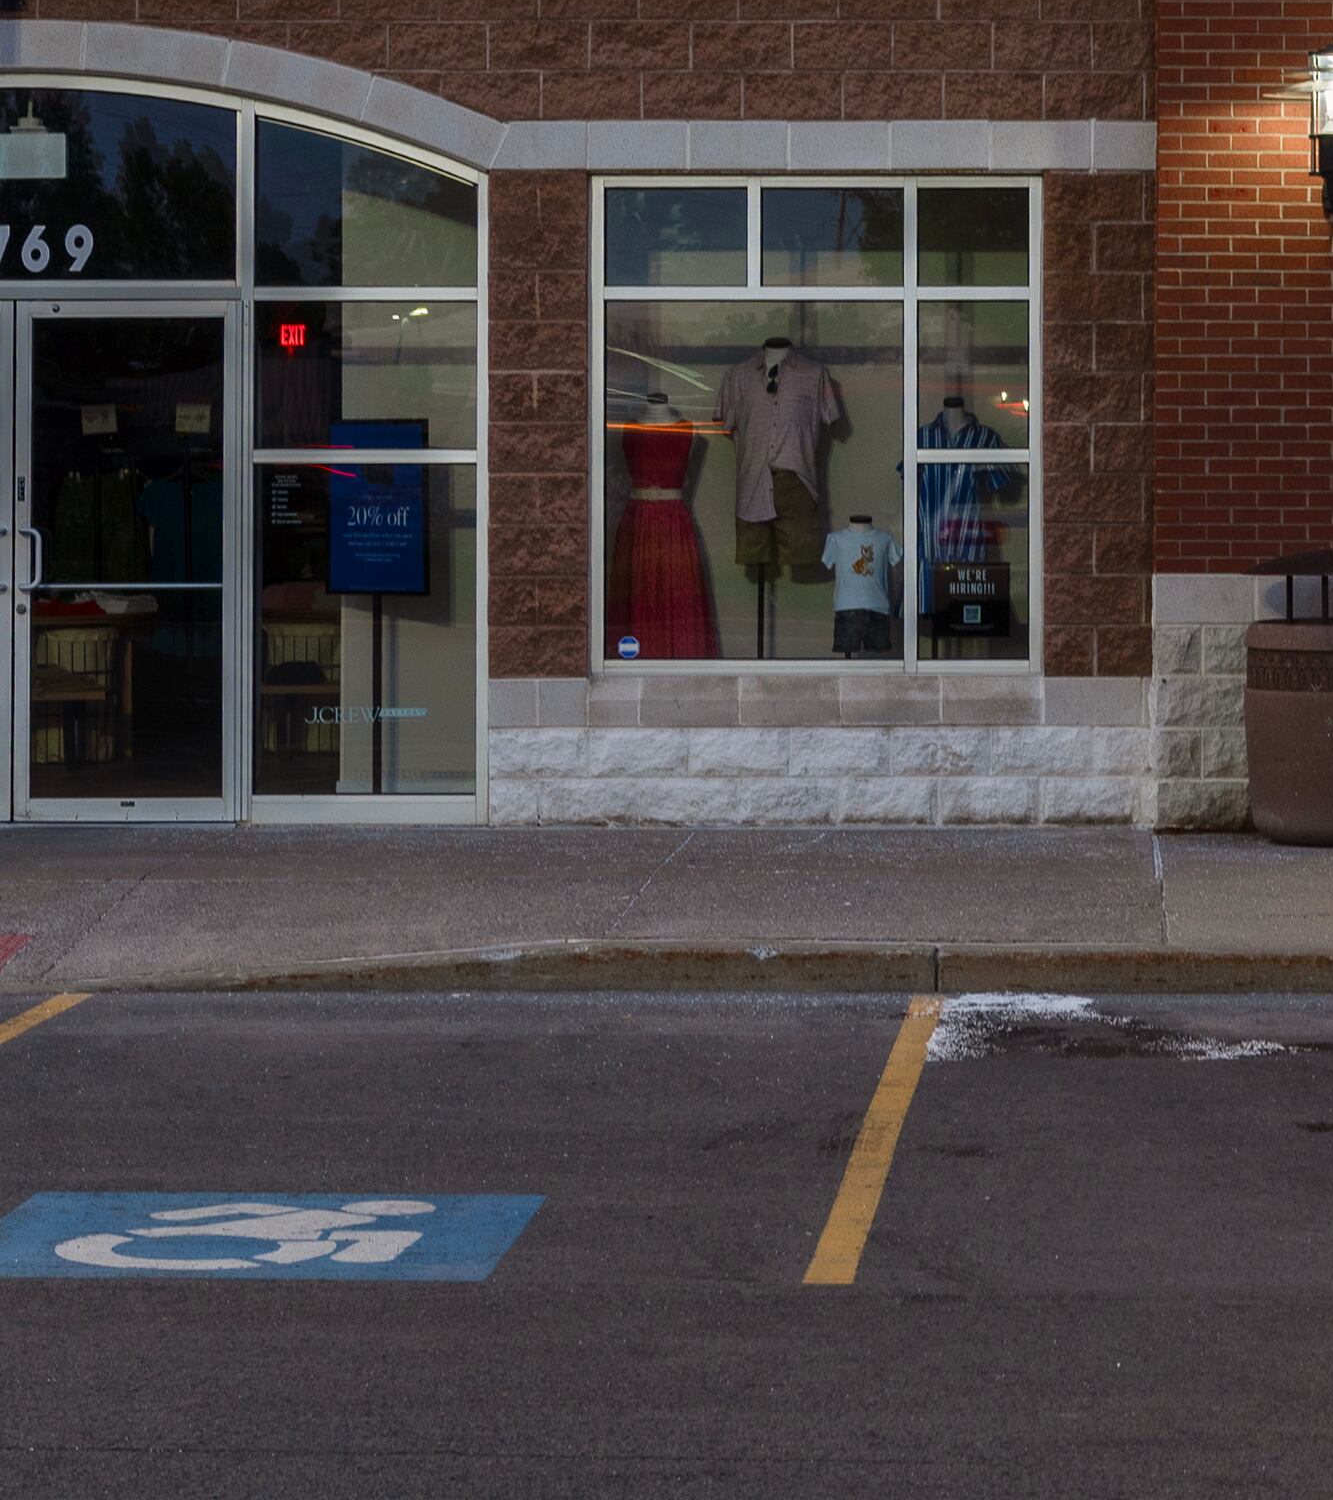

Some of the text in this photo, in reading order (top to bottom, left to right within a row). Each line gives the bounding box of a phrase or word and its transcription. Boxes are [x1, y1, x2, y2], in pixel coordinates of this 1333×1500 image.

[281, 323, 306, 346] EXIT
[347, 505, 410, 527] 20% off
[957, 569, 988, 581] WE'RE
[304, 706, 381, 724] J.CREW
